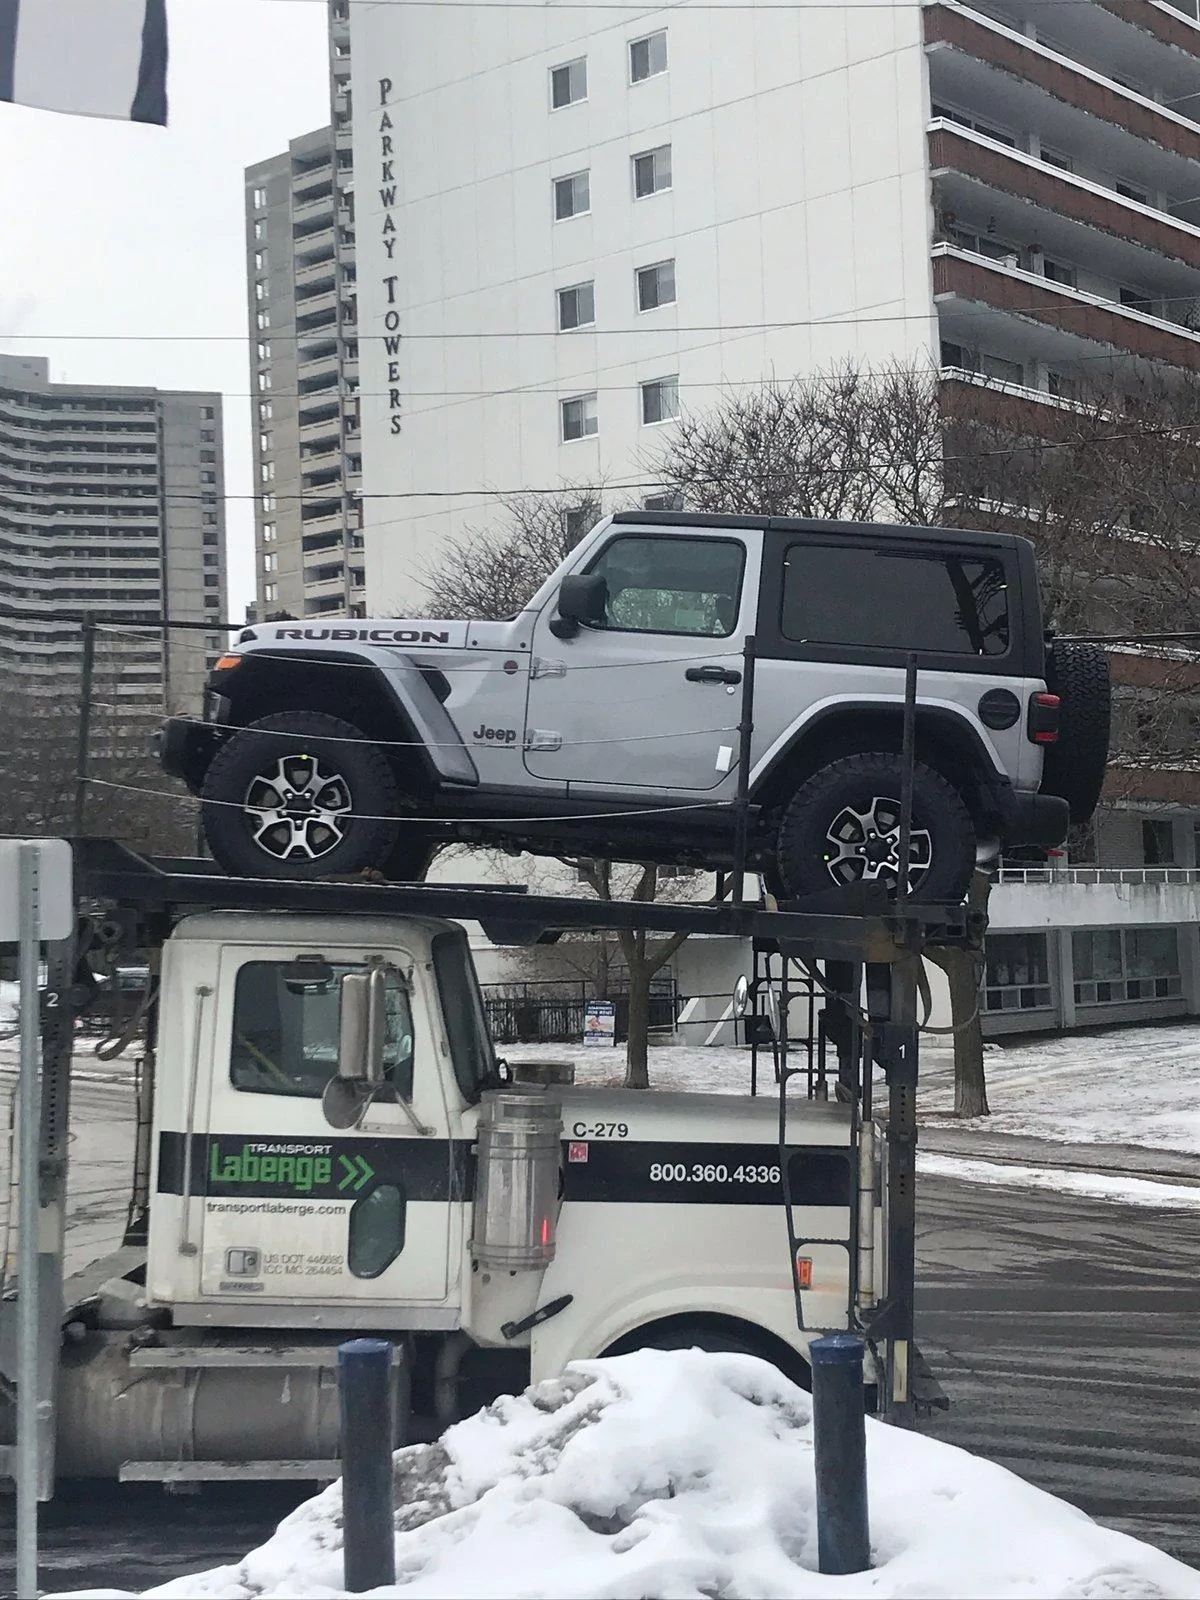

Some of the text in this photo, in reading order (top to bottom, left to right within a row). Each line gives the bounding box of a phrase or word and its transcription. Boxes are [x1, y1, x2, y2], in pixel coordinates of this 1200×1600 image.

[379, 77, 402, 434] PARKWAY TOWERS
[275, 629, 449, 643] RUBICON
[473, 724, 516, 744] Jeep
[46, 992, 59, 1007] 2
[898, 1044, 906, 1059] 1
[573, 1122, 629, 1138] C-279
[250, 1143, 333, 1155] TRANSPORT
[649, 1163, 782, 1184] 800.360.4336
[206, 1202, 347, 1217] transportlaberge.com
[282, 1254, 305, 1265] DOT
